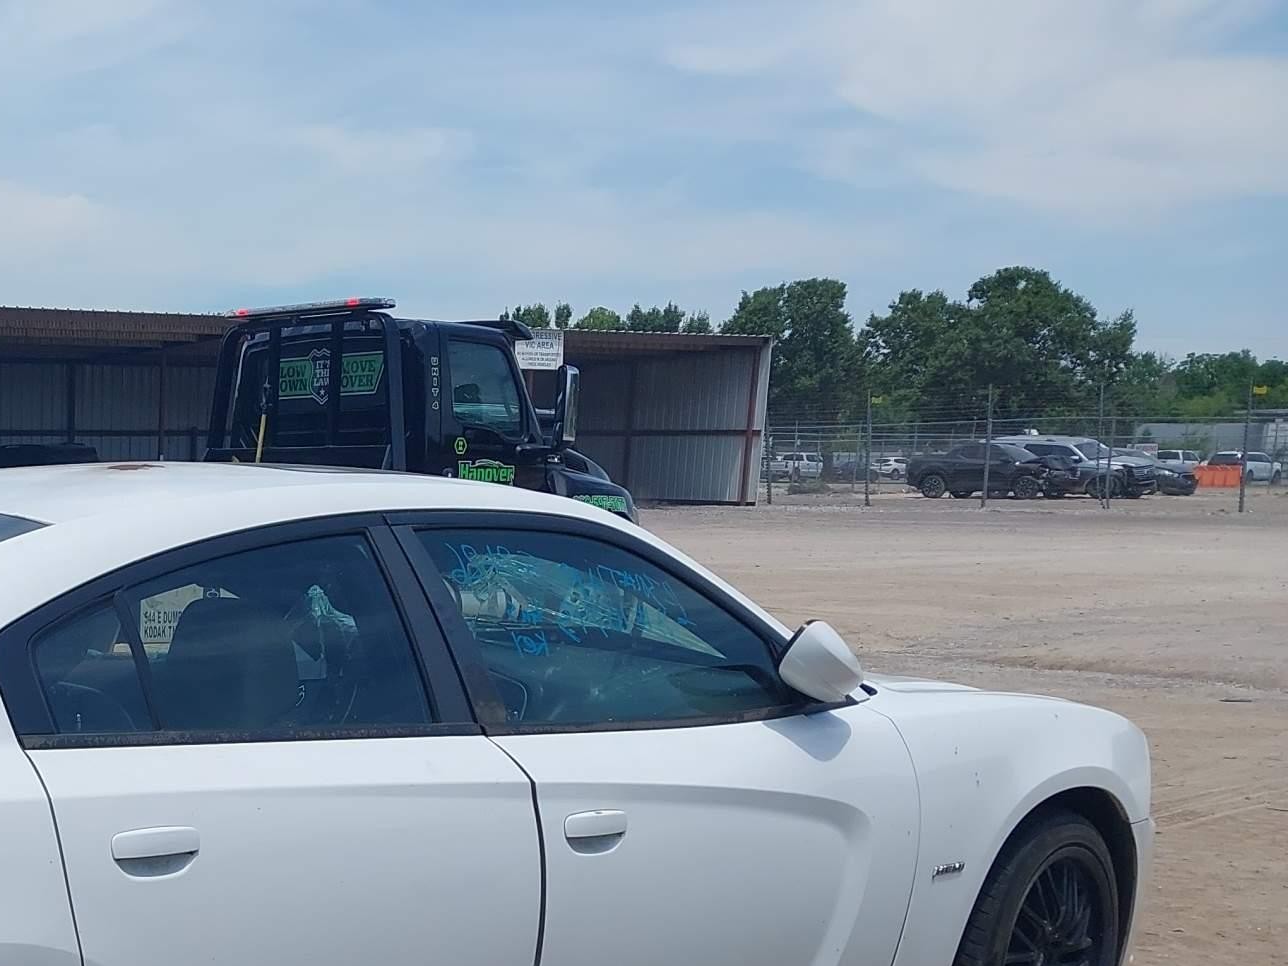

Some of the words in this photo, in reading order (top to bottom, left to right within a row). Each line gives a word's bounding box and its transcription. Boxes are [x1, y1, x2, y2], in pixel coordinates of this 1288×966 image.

[537, 341, 554, 350] AREA
[280, 364, 307, 379] LOW
[315, 369, 330, 378] TH
[430, 357, 439, 397] UNIT
[280, 379, 308, 393] OWN
[341, 374, 375, 388] OVER
[459, 461, 514, 484] Hanover
[157, 611, 162, 624] E
[144, 625, 166, 638] KODAK
